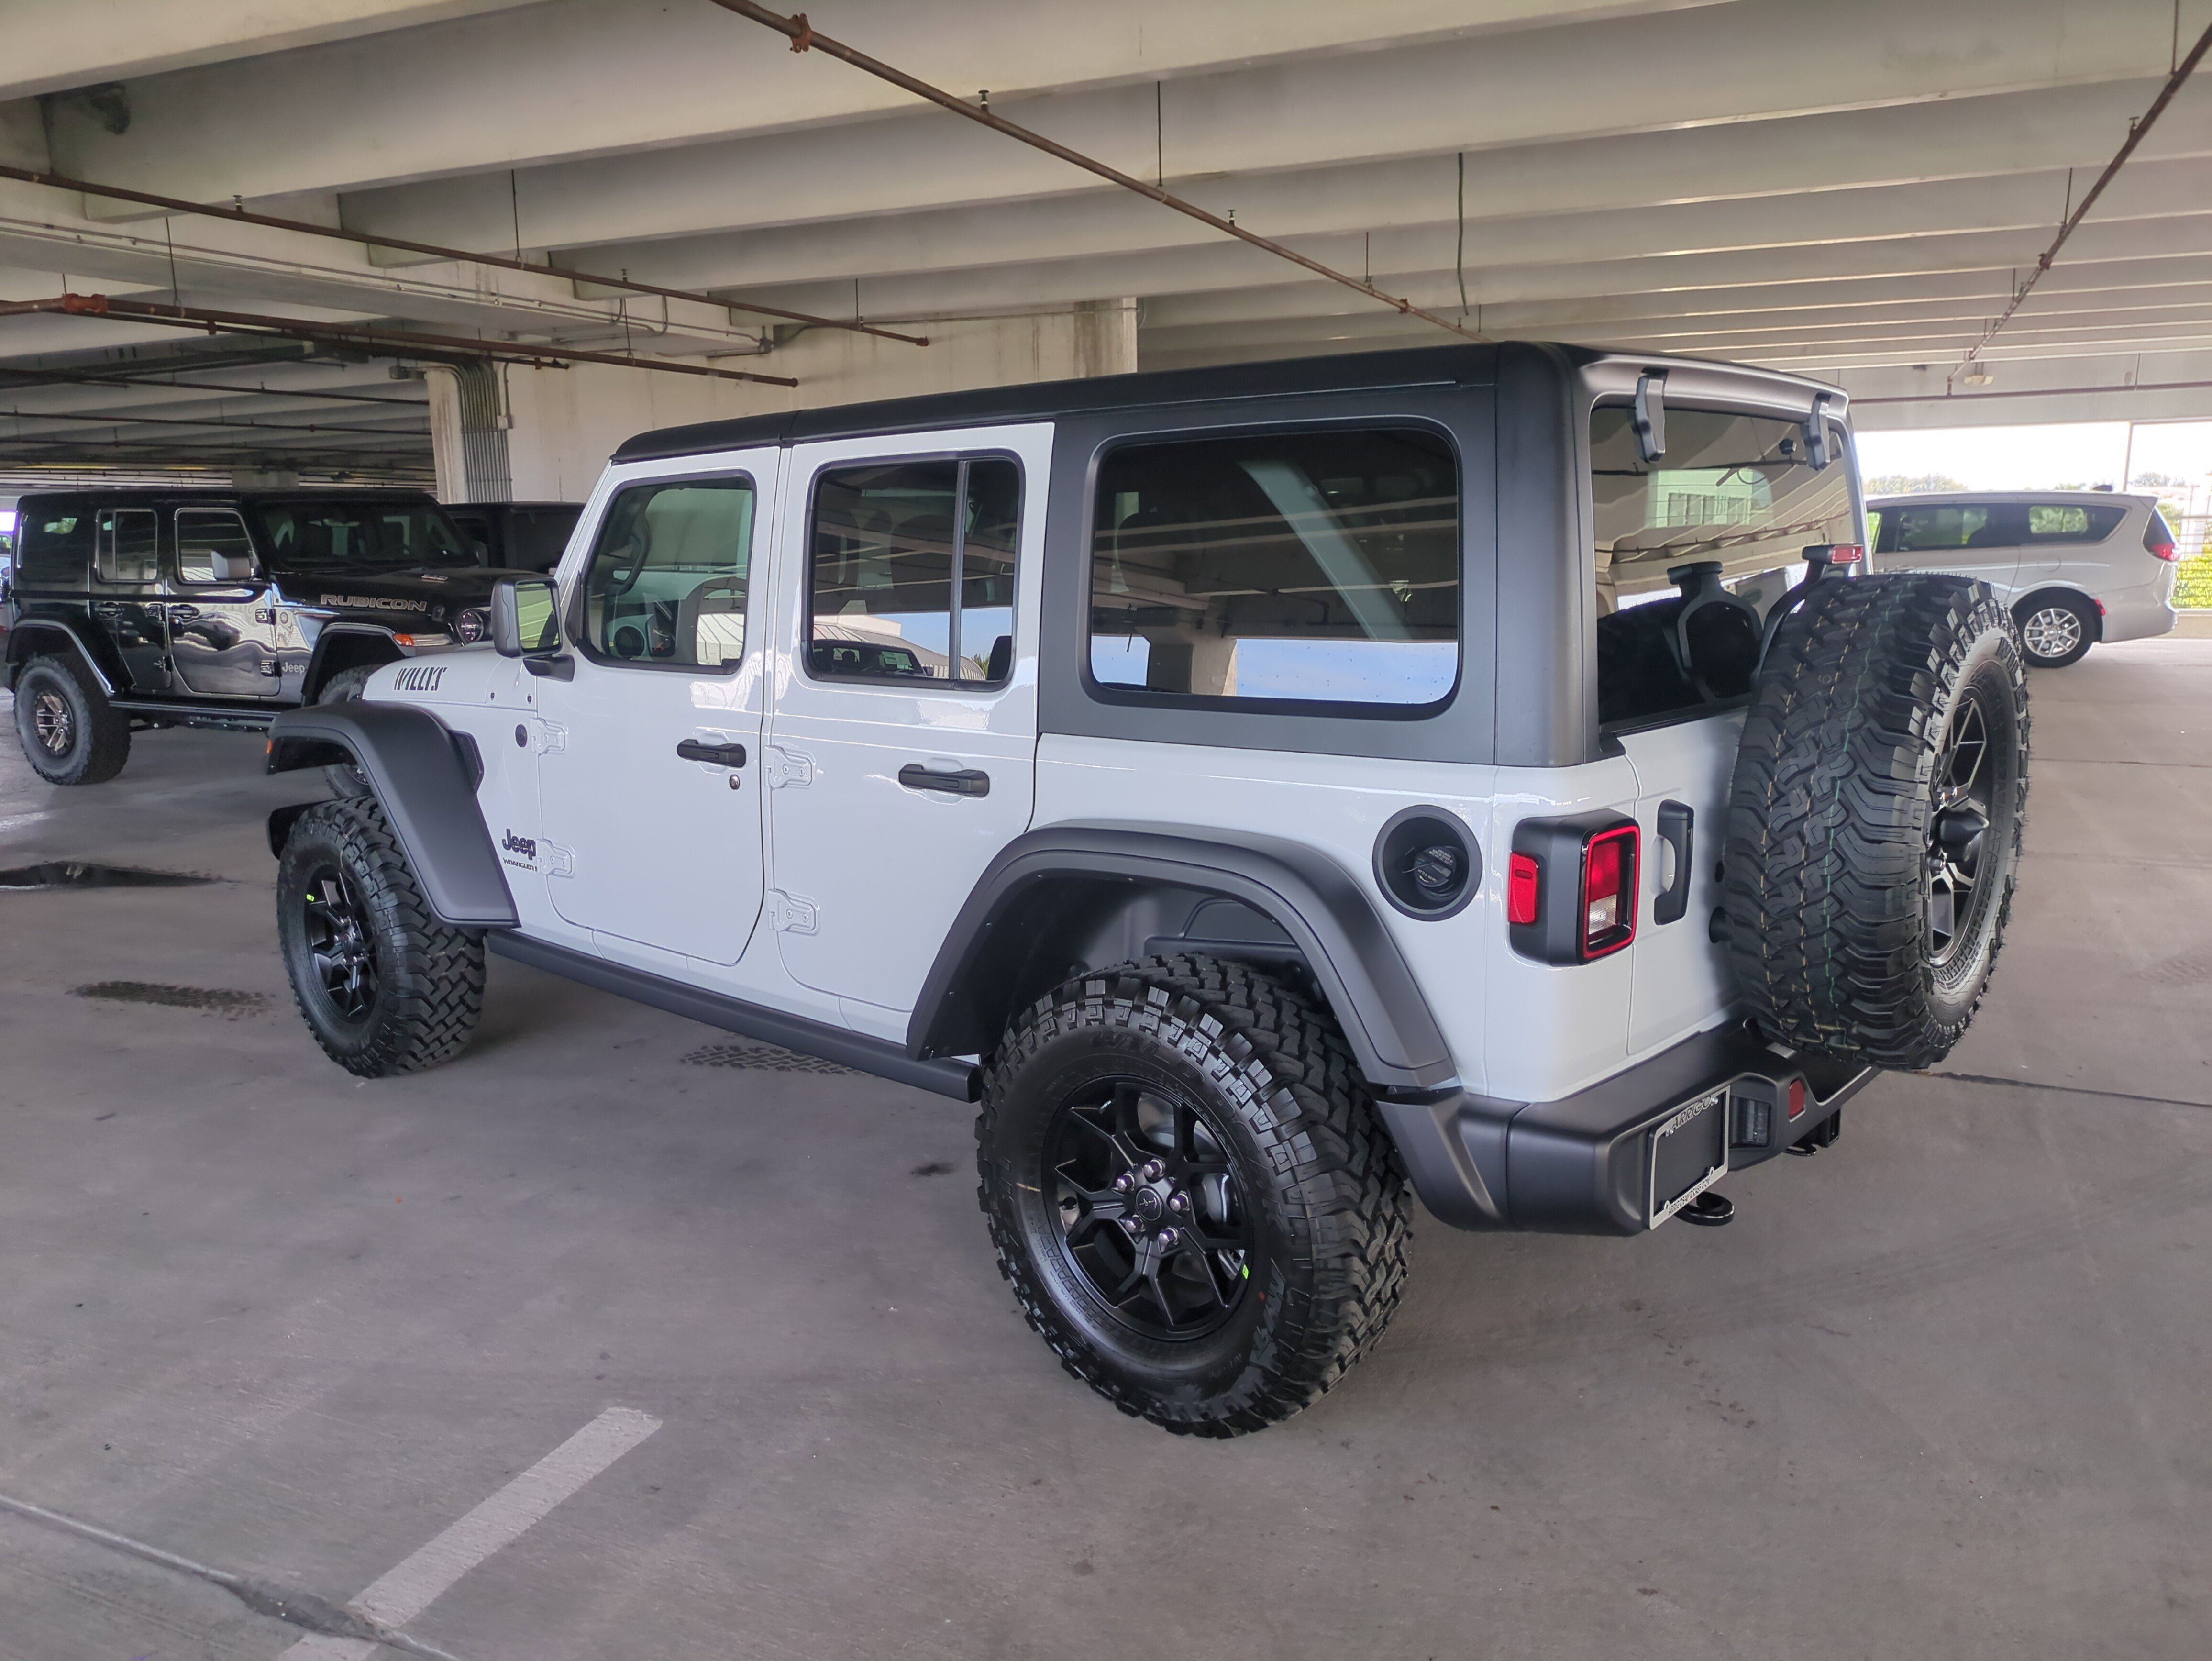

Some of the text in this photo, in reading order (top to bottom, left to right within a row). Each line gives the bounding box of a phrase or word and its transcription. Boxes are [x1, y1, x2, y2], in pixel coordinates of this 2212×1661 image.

[320, 594, 427, 612] RUBICON
[281, 661, 305, 675] Jeep
[394, 667, 448, 691] WILLYS
[502, 829, 536, 861] Jeep
[503, 857, 534, 871] WRANGLER
[1671, 1095, 1712, 1129] ARRIGO
